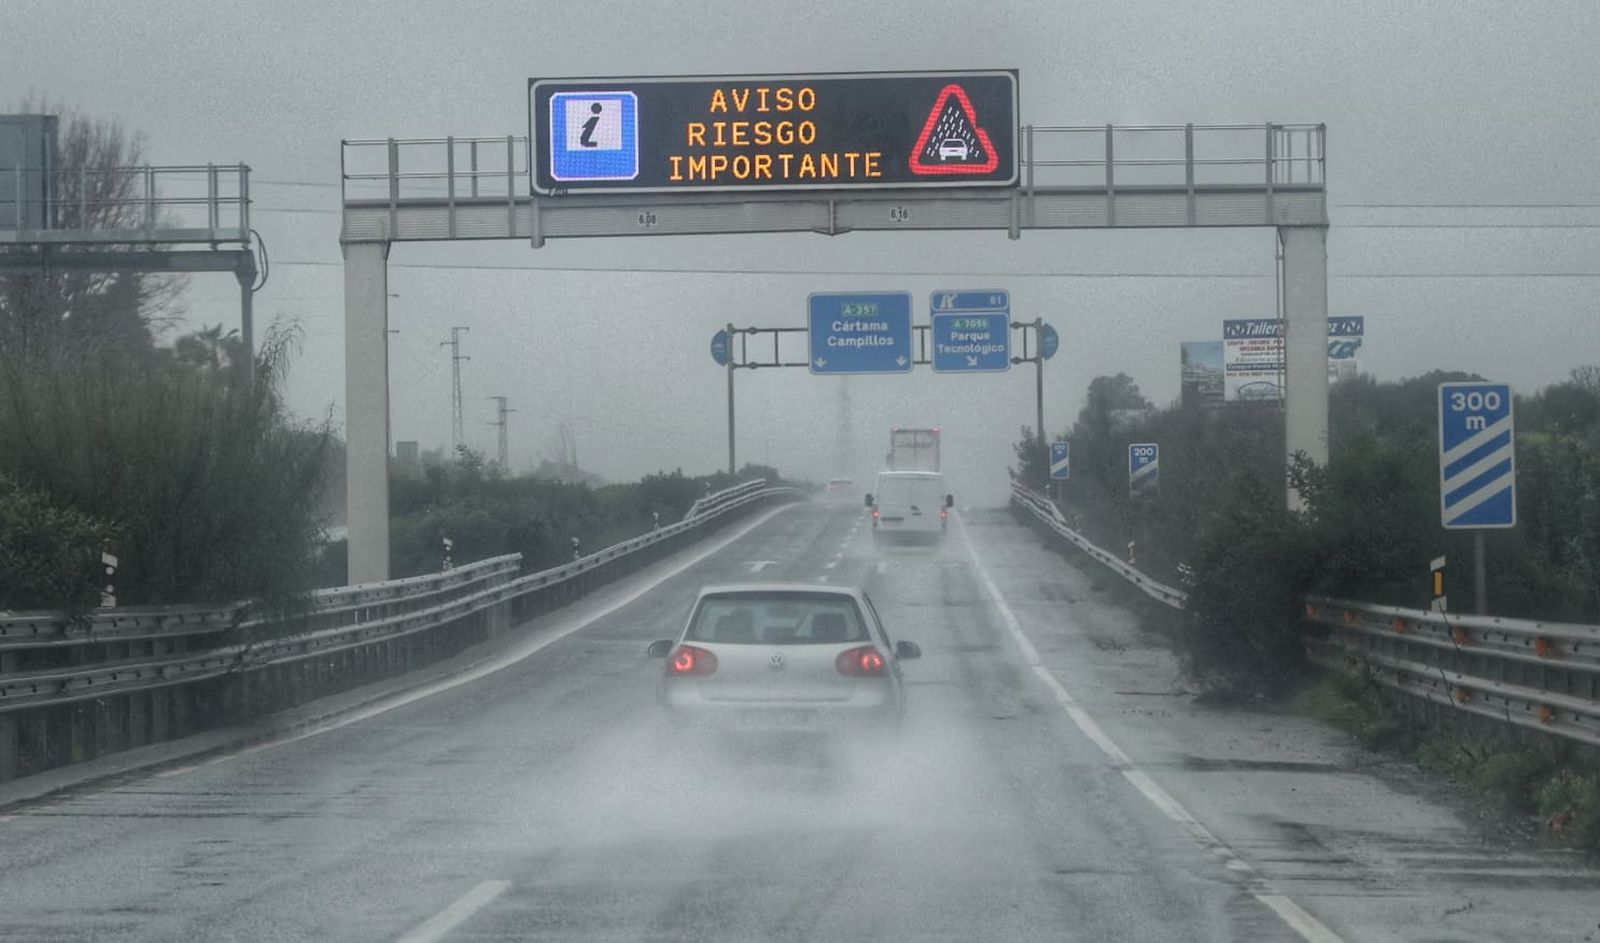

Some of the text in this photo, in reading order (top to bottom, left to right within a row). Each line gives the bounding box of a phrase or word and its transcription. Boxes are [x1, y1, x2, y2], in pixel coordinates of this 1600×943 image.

[710, 87, 816, 112] AVISO
[688, 121, 817, 147] RIESGO
[669, 152, 882, 181] IMPORTANTE
[831, 319, 889, 333] Cártama
[827, 334, 895, 349] Campillos
[951, 332, 991, 343] Parque
[937, 343, 1005, 356] Tecnológico
[1450, 392, 1501, 412] 300
[1465, 415, 1487, 431] m
[1134, 447, 1154, 456] 200
[1139, 456, 1148, 464] m
